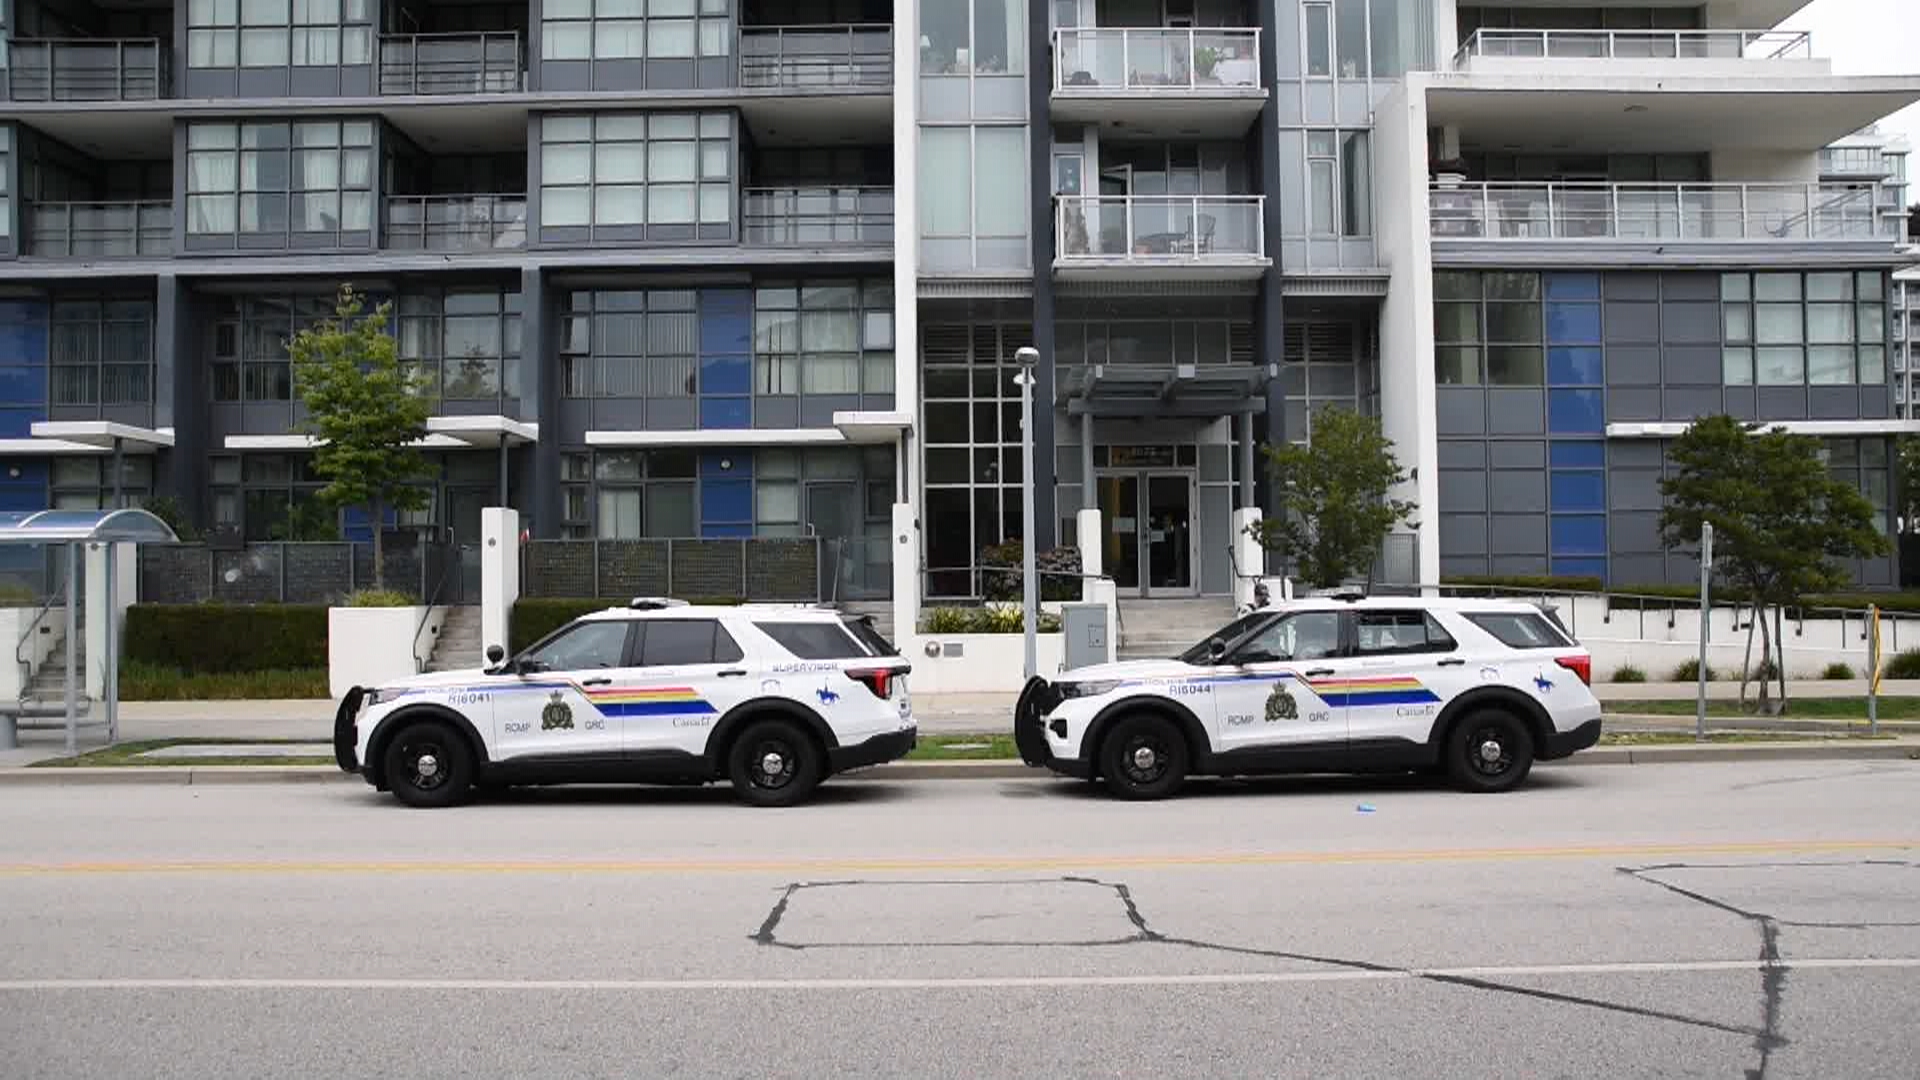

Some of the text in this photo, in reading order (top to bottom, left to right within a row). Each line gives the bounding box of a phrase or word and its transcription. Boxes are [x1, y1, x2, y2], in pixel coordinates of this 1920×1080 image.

[773, 662, 838, 672] SUPERVISOR
[1227, 711, 1329, 726] RCMP GRC
[504, 720, 605, 733] RCMP GRC
